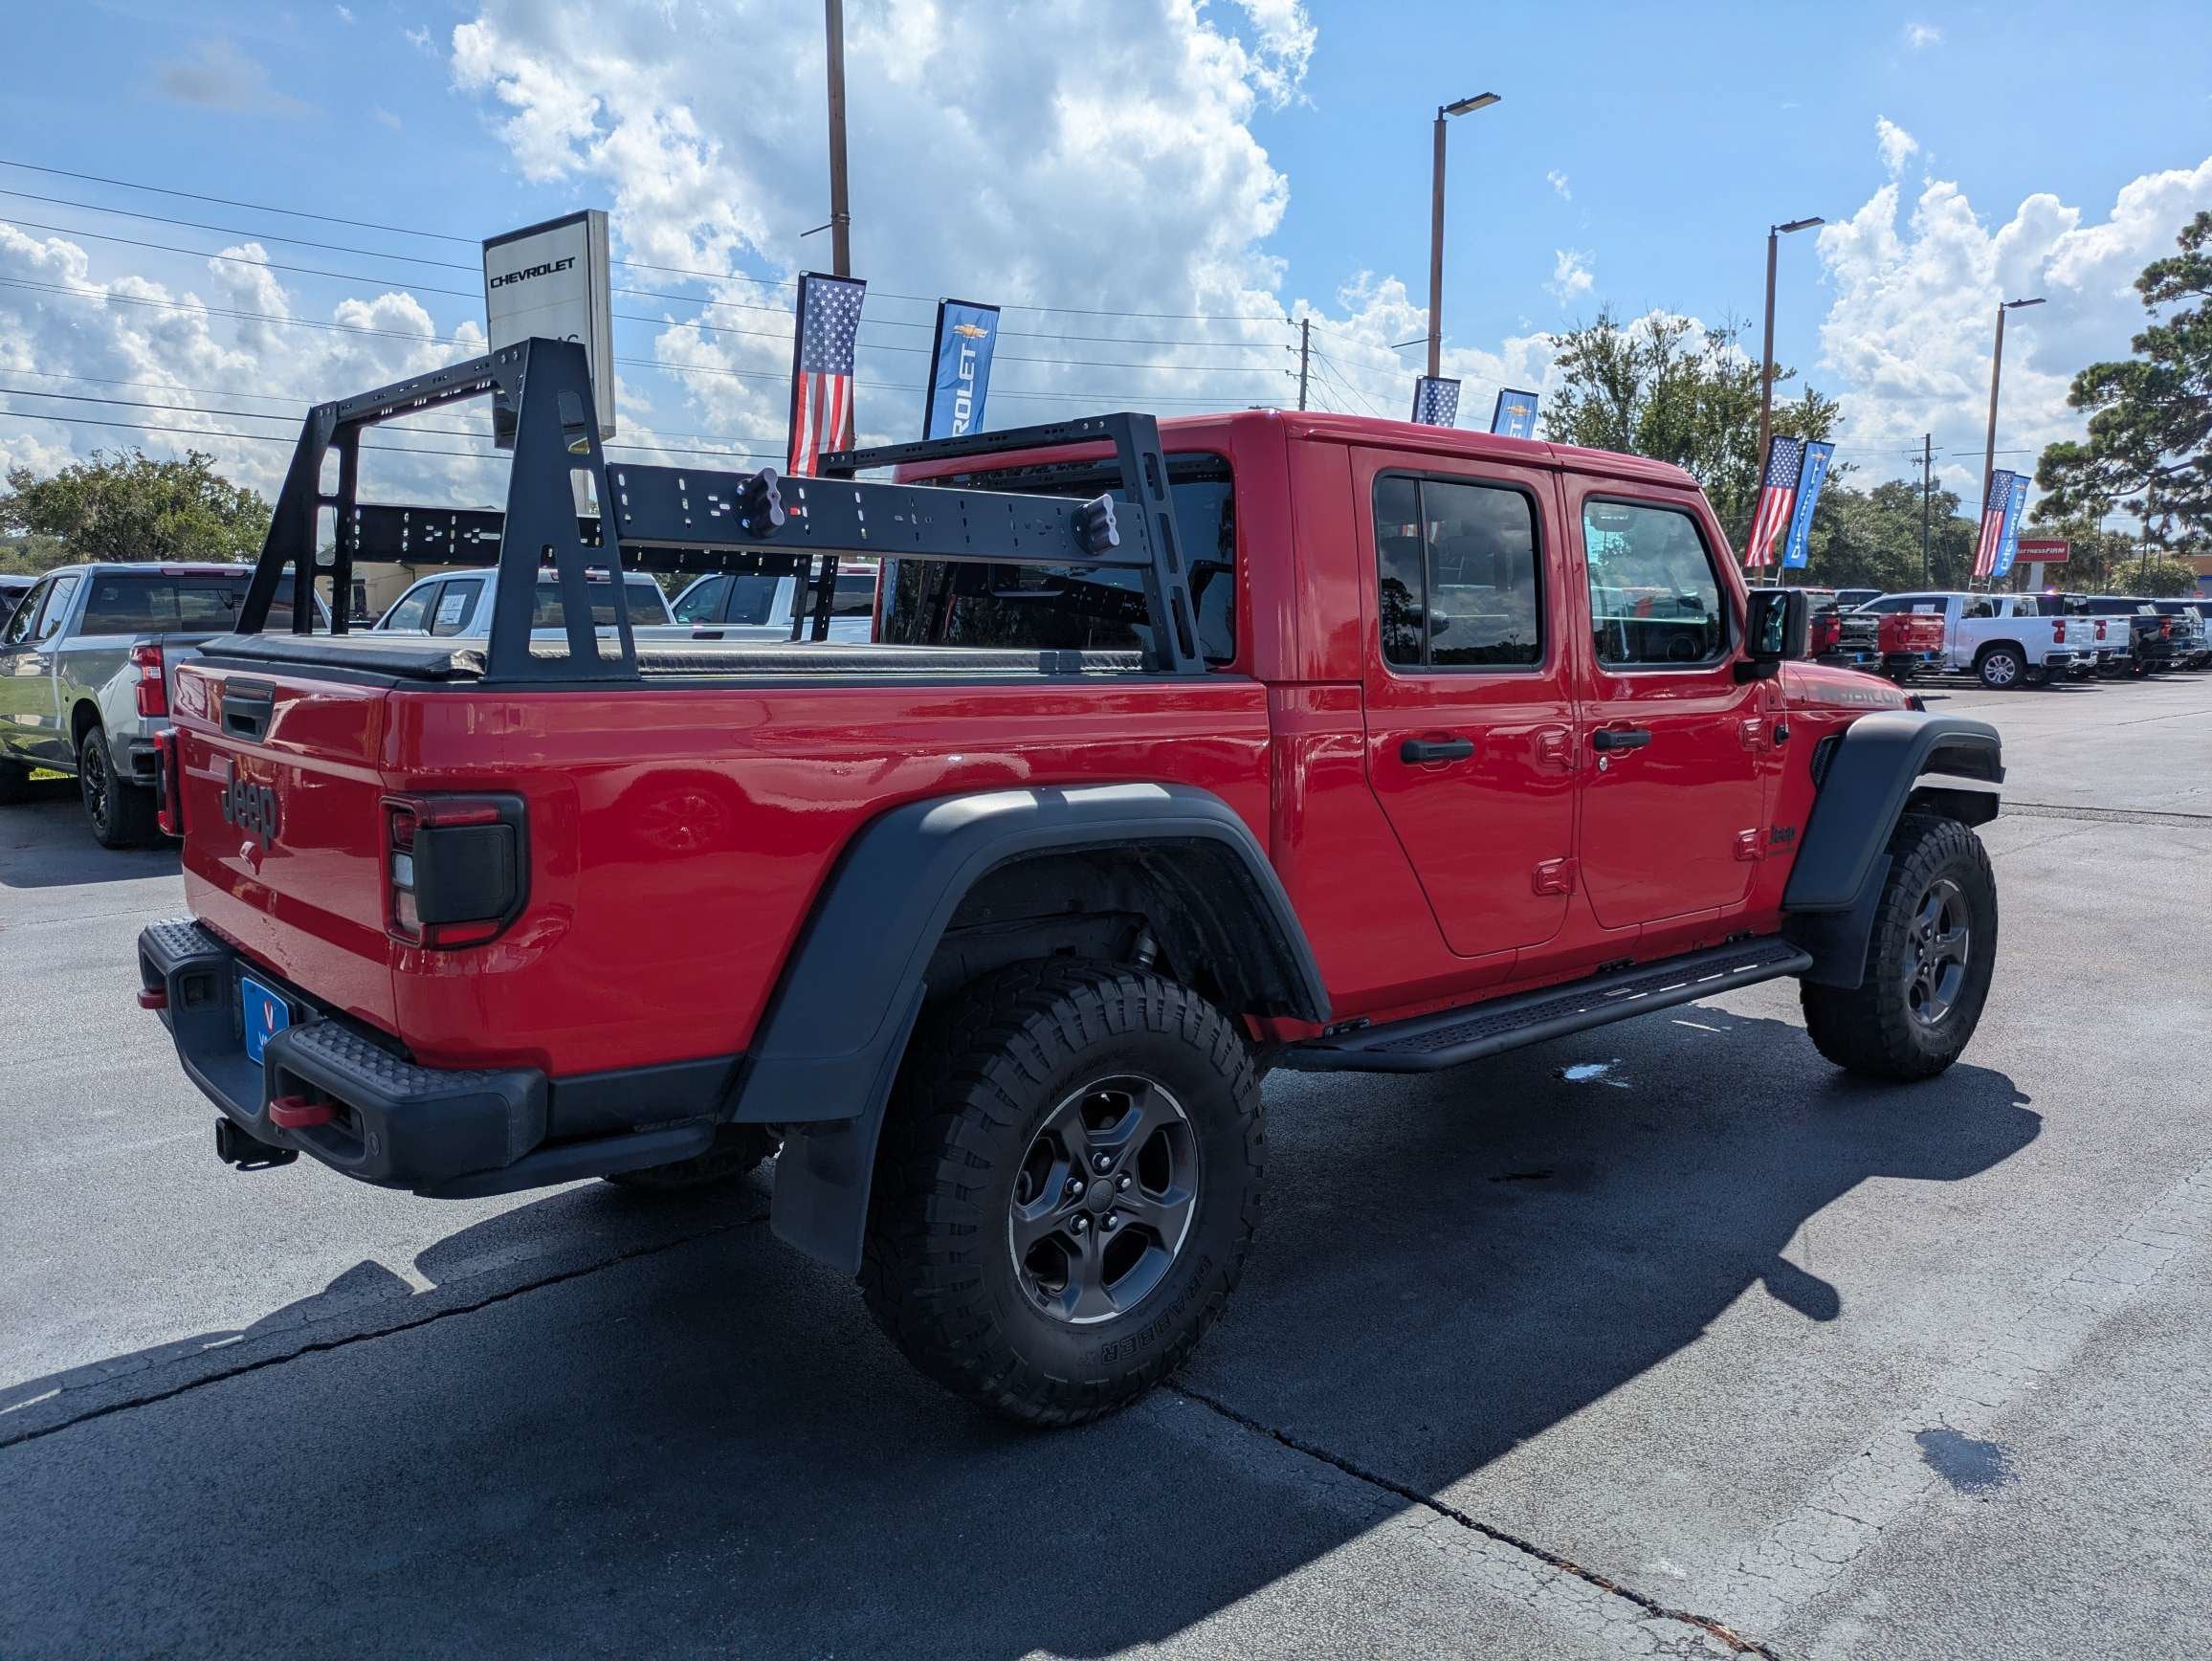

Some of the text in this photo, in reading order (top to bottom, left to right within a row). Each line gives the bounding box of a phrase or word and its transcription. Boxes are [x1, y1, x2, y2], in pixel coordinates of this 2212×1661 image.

[490, 256, 576, 289] CHEVROLET
[1833, 687, 1905, 706] UBICON
[221, 760, 277, 851] Jeep
[1102, 1255, 1213, 1364] GRABBER
